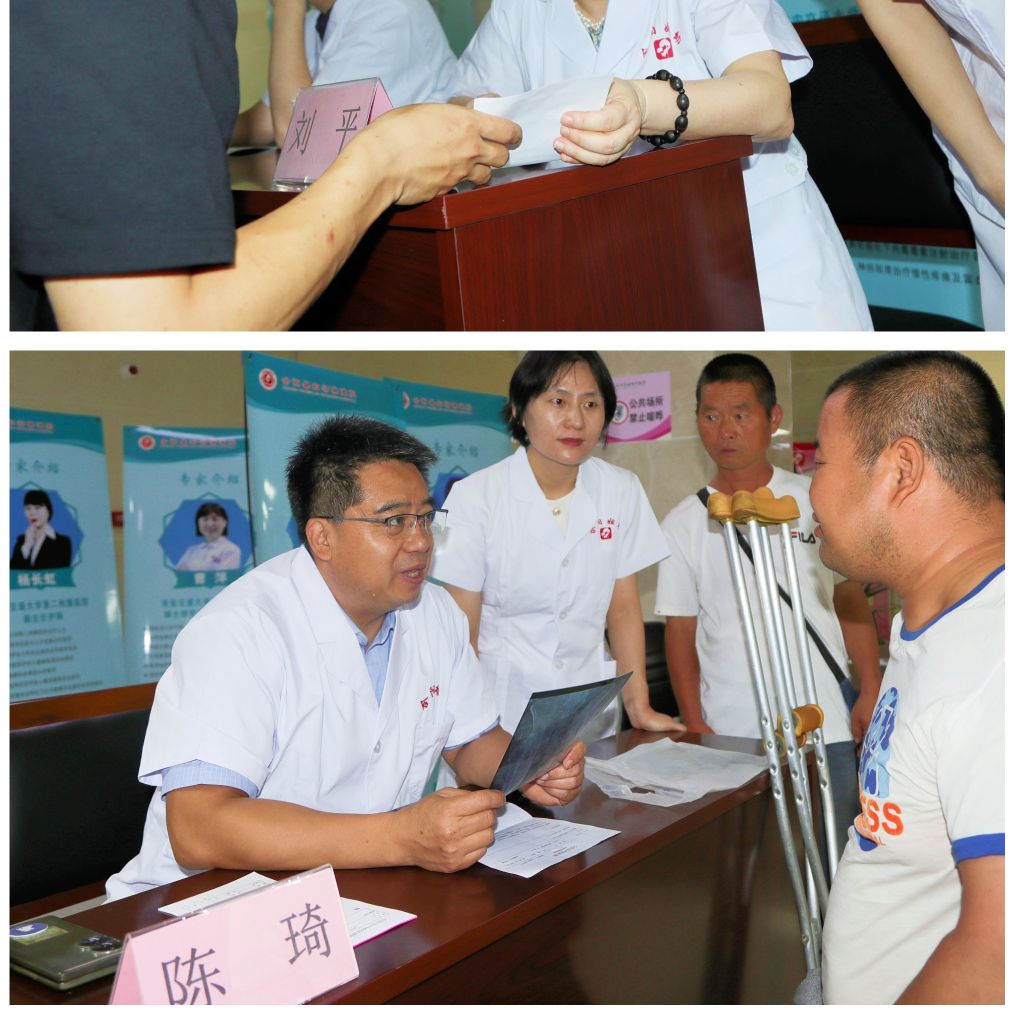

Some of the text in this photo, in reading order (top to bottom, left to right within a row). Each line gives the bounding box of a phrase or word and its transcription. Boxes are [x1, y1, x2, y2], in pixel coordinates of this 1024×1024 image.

[287, 106, 361, 157] 刘平
[629, 396, 664, 409] 公共场所
[629, 410, 664, 423] 禁止喧哗
[791, 530, 817, 544] FILA
[861, 797, 905, 837] SS
[161, 902, 333, 1004] 陈琦
